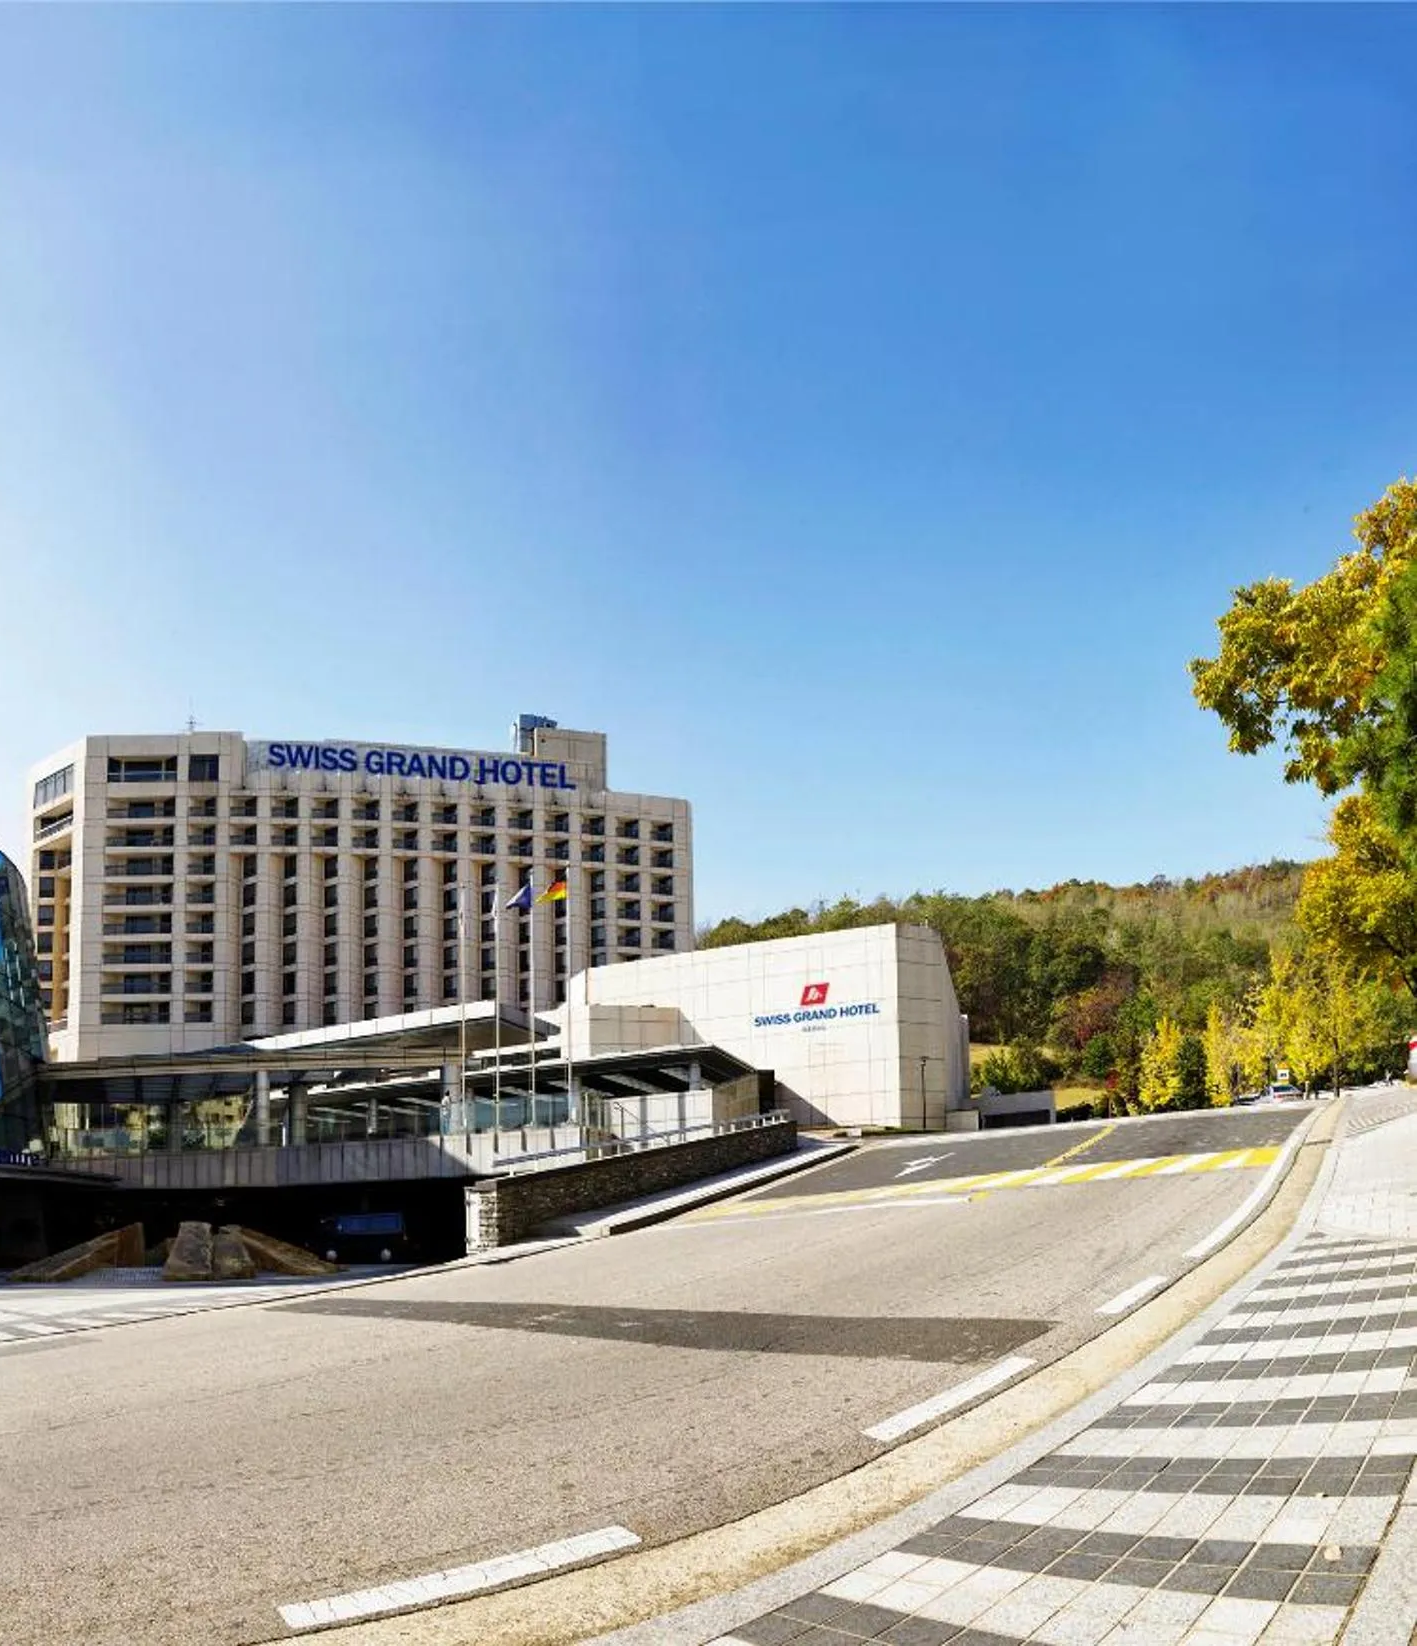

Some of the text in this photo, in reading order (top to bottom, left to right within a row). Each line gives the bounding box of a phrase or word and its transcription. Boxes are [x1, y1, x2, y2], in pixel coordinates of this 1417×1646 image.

[268, 743, 577, 790] SWISS GRAND HOTEL
[754, 1003, 880, 1027] SWISS GRAND HOTEL
